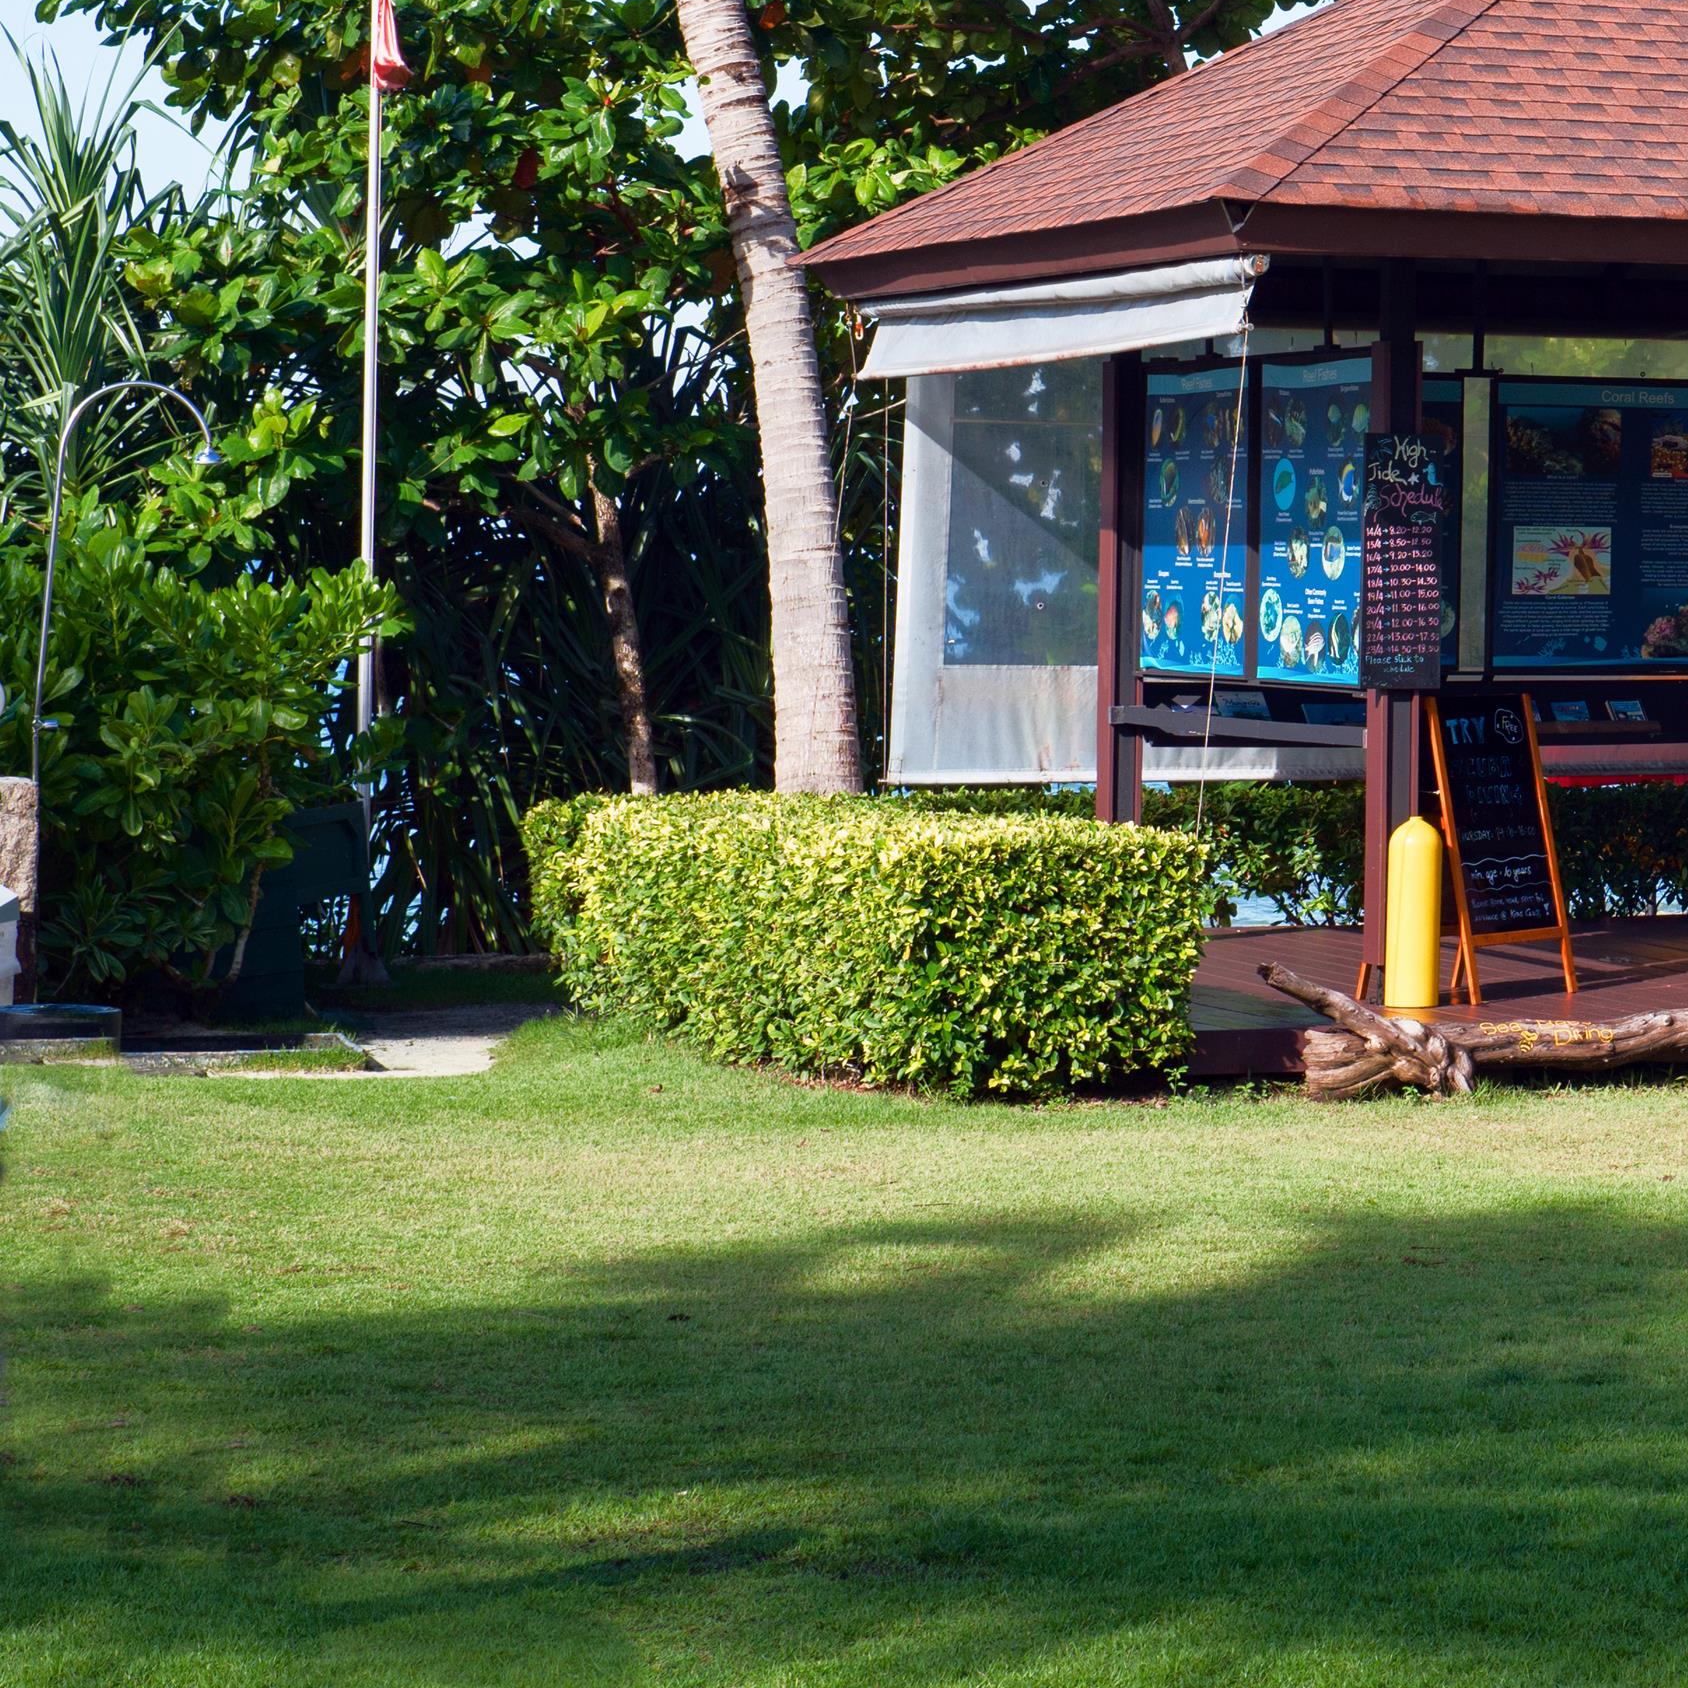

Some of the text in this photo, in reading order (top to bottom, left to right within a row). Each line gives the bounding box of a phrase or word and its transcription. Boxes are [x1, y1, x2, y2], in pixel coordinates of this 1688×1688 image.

[1601, 390, 1675, 404] Coral Reefs
[1368, 460, 1408, 486] Tide
[1374, 483, 1443, 522] Schedule
[1444, 716, 1486, 745] TRY
